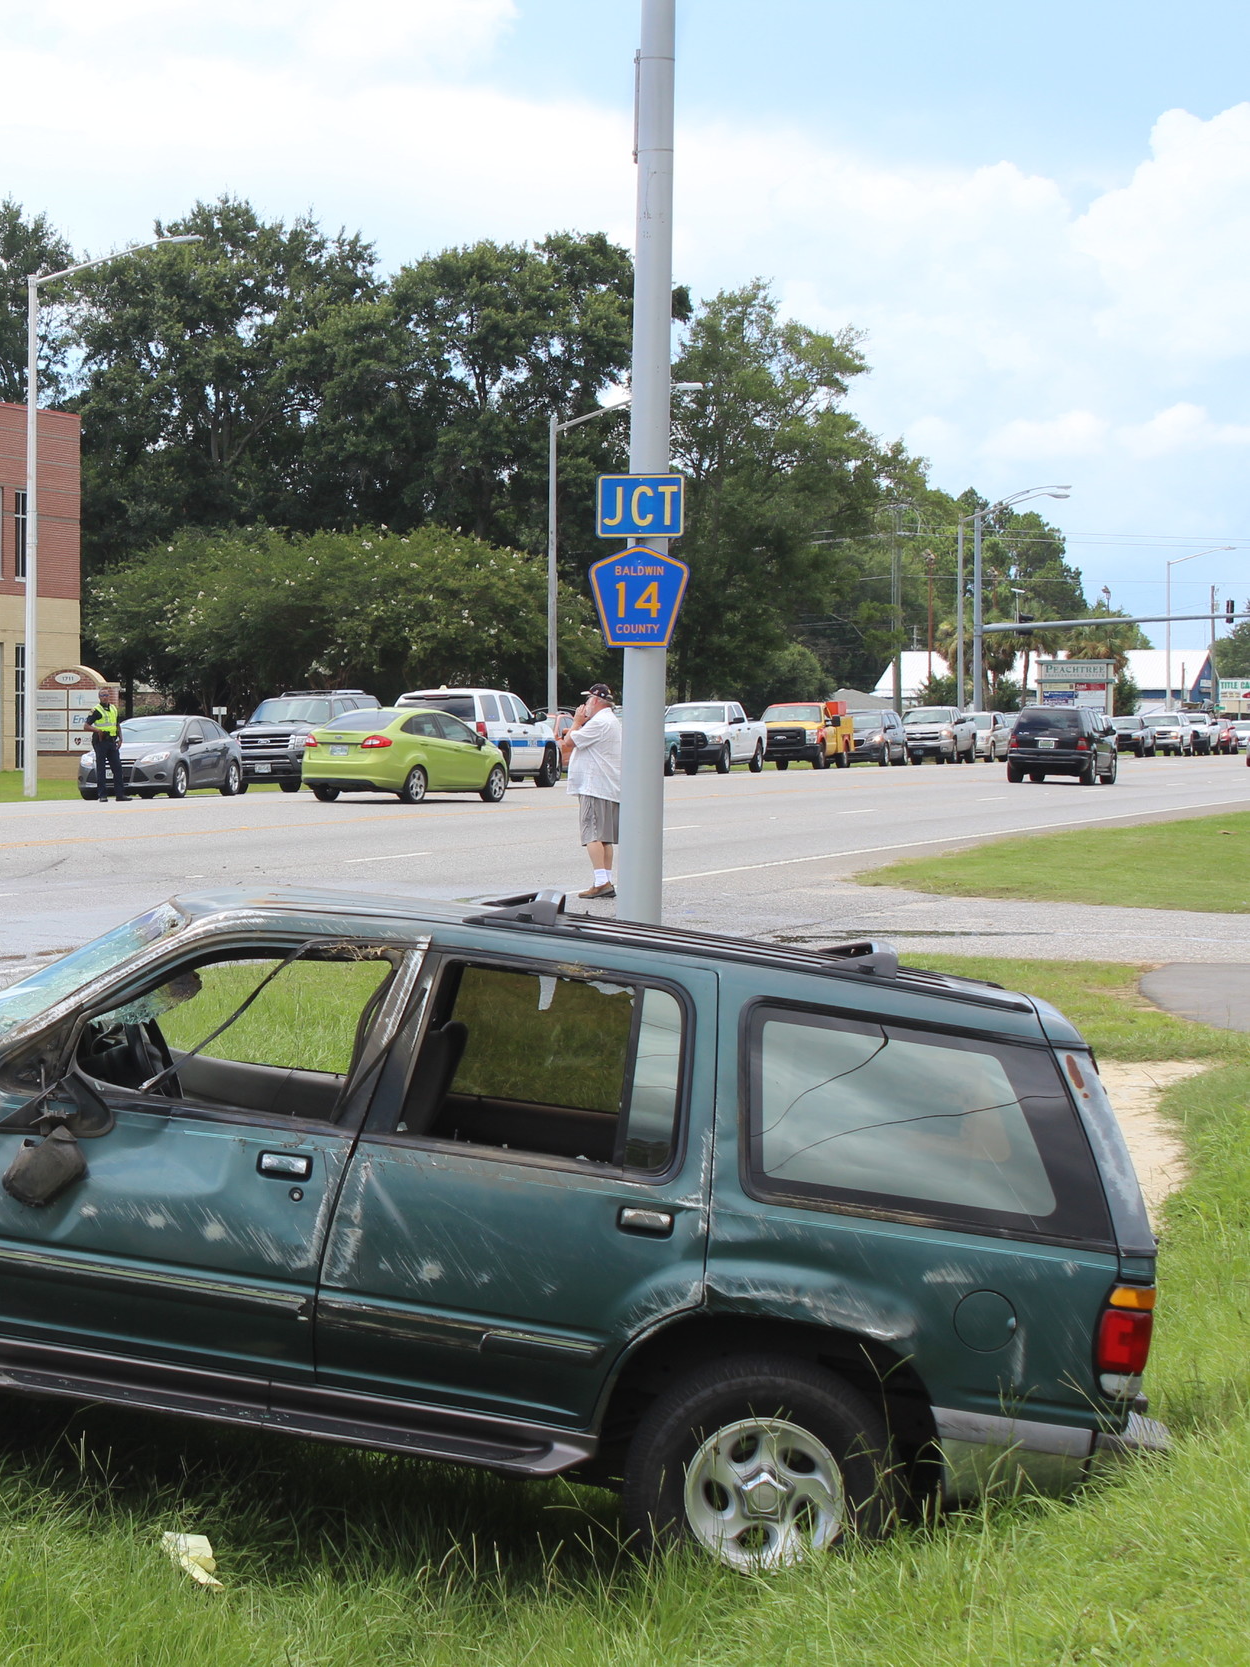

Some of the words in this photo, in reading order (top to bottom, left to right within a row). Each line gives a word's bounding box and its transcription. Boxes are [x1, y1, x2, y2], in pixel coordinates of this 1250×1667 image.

[602, 485, 678, 527] JCT
[614, 566, 665, 576] BALDWIN
[615, 582, 661, 618] 14
[616, 624, 660, 634] COUNTY
[1045, 664, 1105, 673] PEACHTREE
[1220, 681, 1237, 689] TITLE
